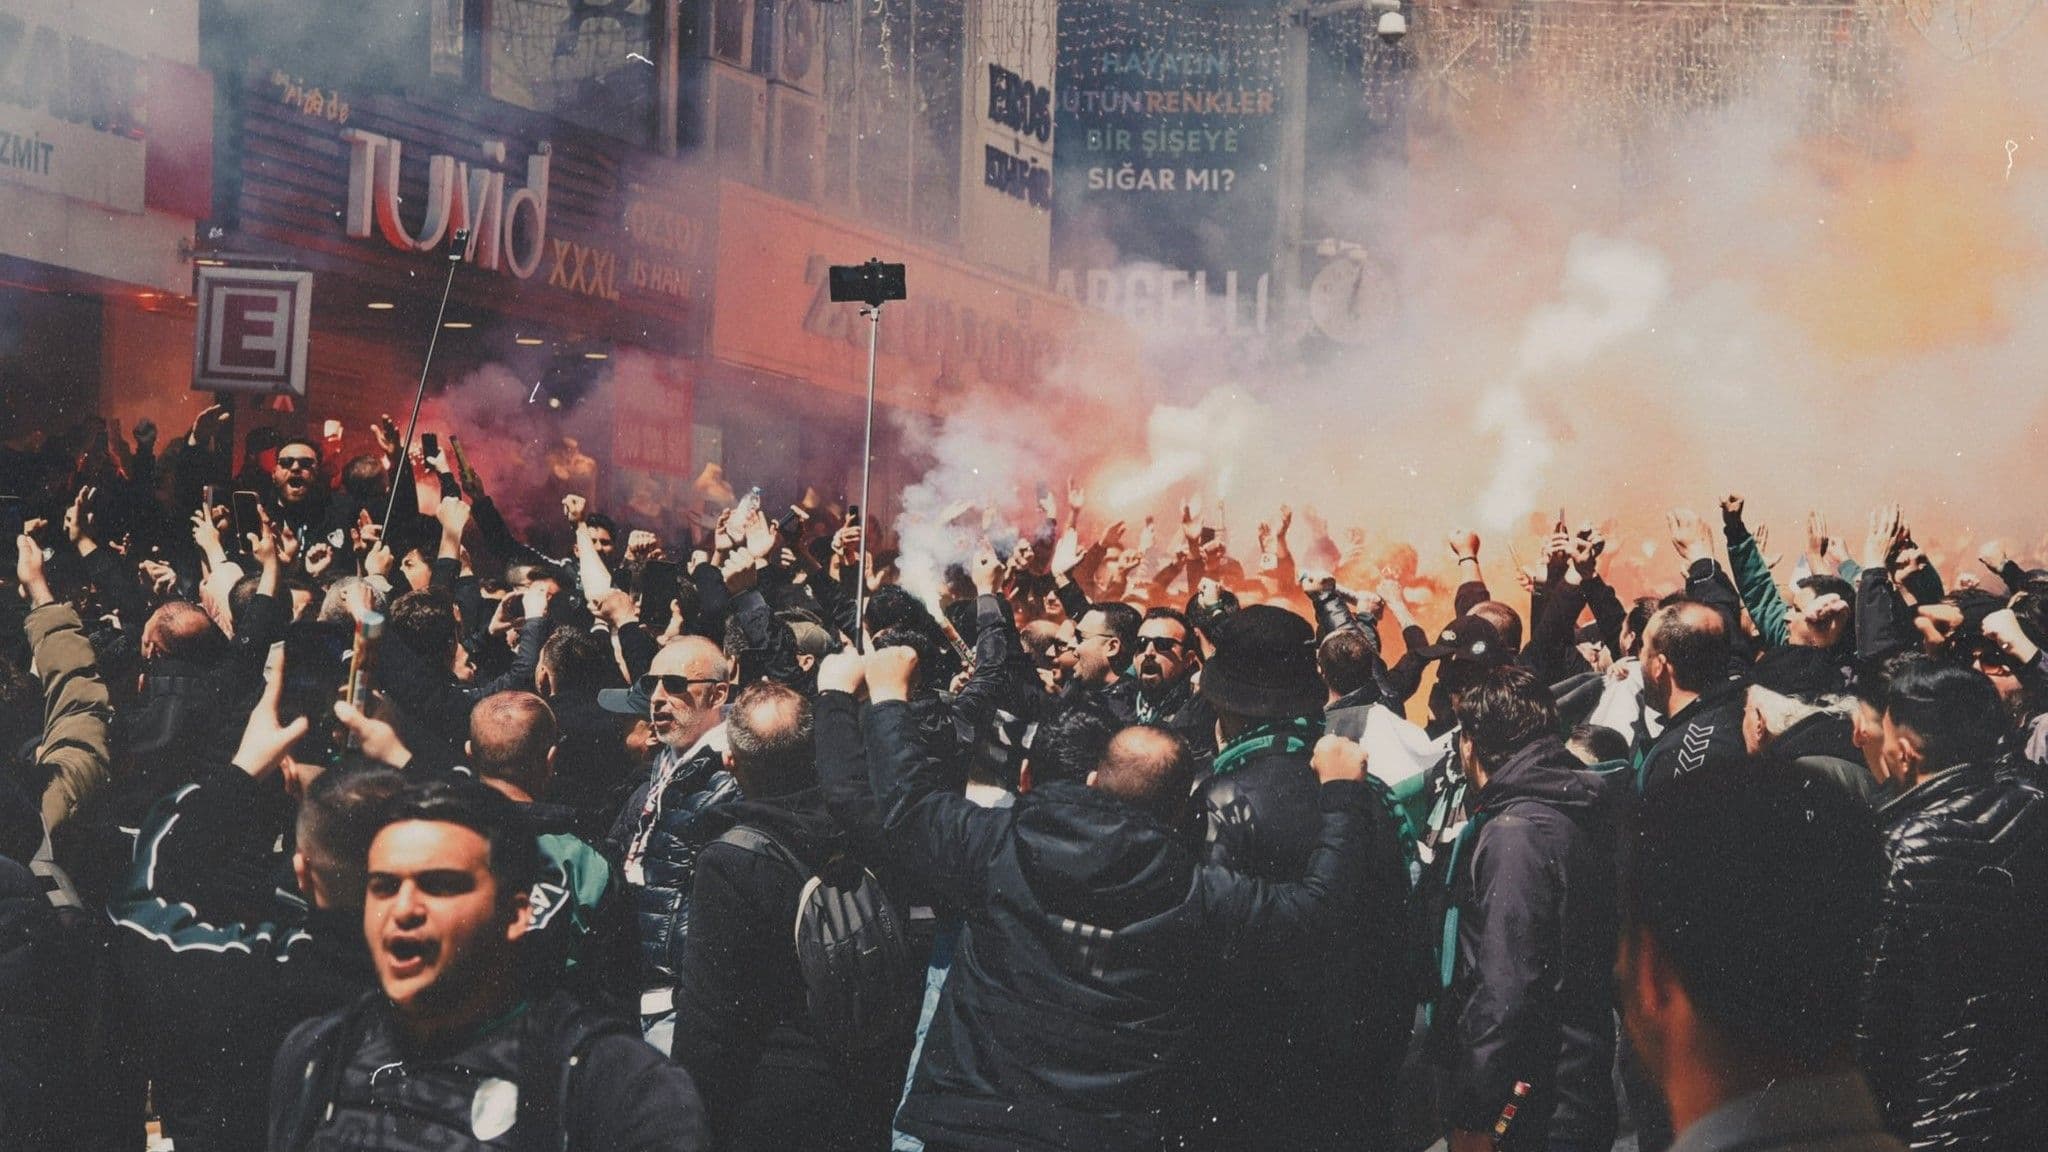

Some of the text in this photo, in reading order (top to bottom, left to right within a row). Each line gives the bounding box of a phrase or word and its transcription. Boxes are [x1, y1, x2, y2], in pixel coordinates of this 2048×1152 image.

[1054, 85, 1274, 114] ÜTÜN RENKLER
[1087, 123, 1238, 158] BİR ŞİŞEYE
[1088, 162, 1235, 191] SIĞAR MI?
[549, 238, 620, 300] XXXL
[220, 294, 279, 369] E
